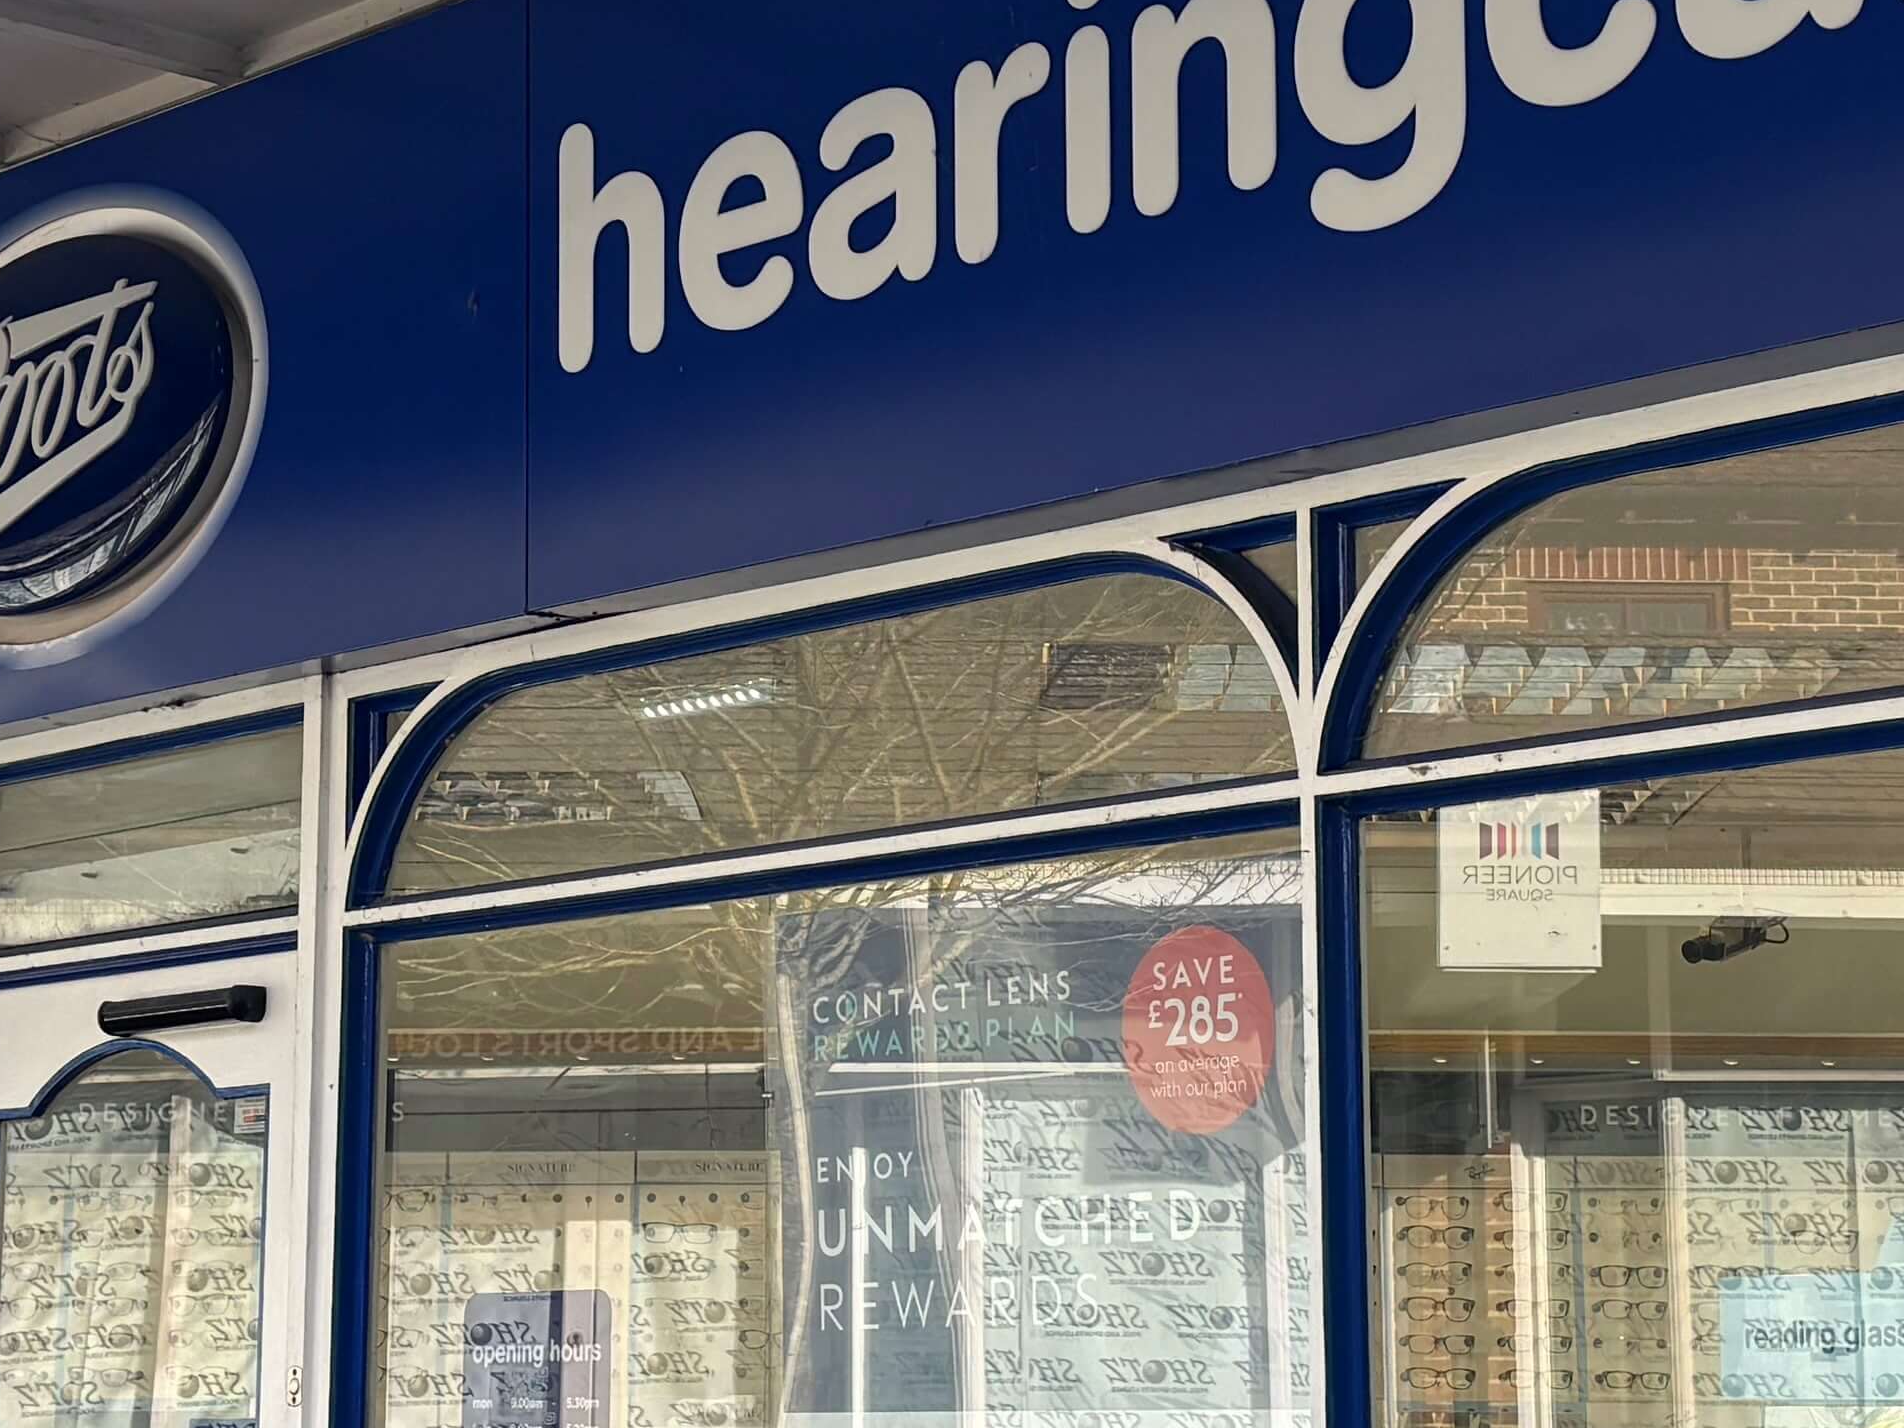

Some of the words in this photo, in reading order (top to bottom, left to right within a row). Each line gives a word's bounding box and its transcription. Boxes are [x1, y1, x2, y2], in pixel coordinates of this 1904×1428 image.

[1152, 954, 1235, 991] SAVE
[812, 981, 970, 1025] CONTACT
[986, 970, 1072, 1008] LENS
[984, 1010, 1076, 1047] PLAN
[1155, 1060, 1174, 1074] on
[1178, 1055, 1240, 1075] average
[1151, 1082, 1181, 1098] with
[1185, 1082, 1209, 1096] our
[1214, 1076, 1247, 1099] plan
[507, 1163, 576, 1173] SIGNATURE
[818, 1189, 1201, 1257] UNMATCHED
[820, 1272, 1097, 1331] REWARDS
[473, 1340, 544, 1367] opening
[550, 1340, 601, 1363] hours
[1744, 1321, 1837, 1354] reading
[472, 1399, 493, 1409] mon
[566, 1398, 599, 1411] 5.30pm
